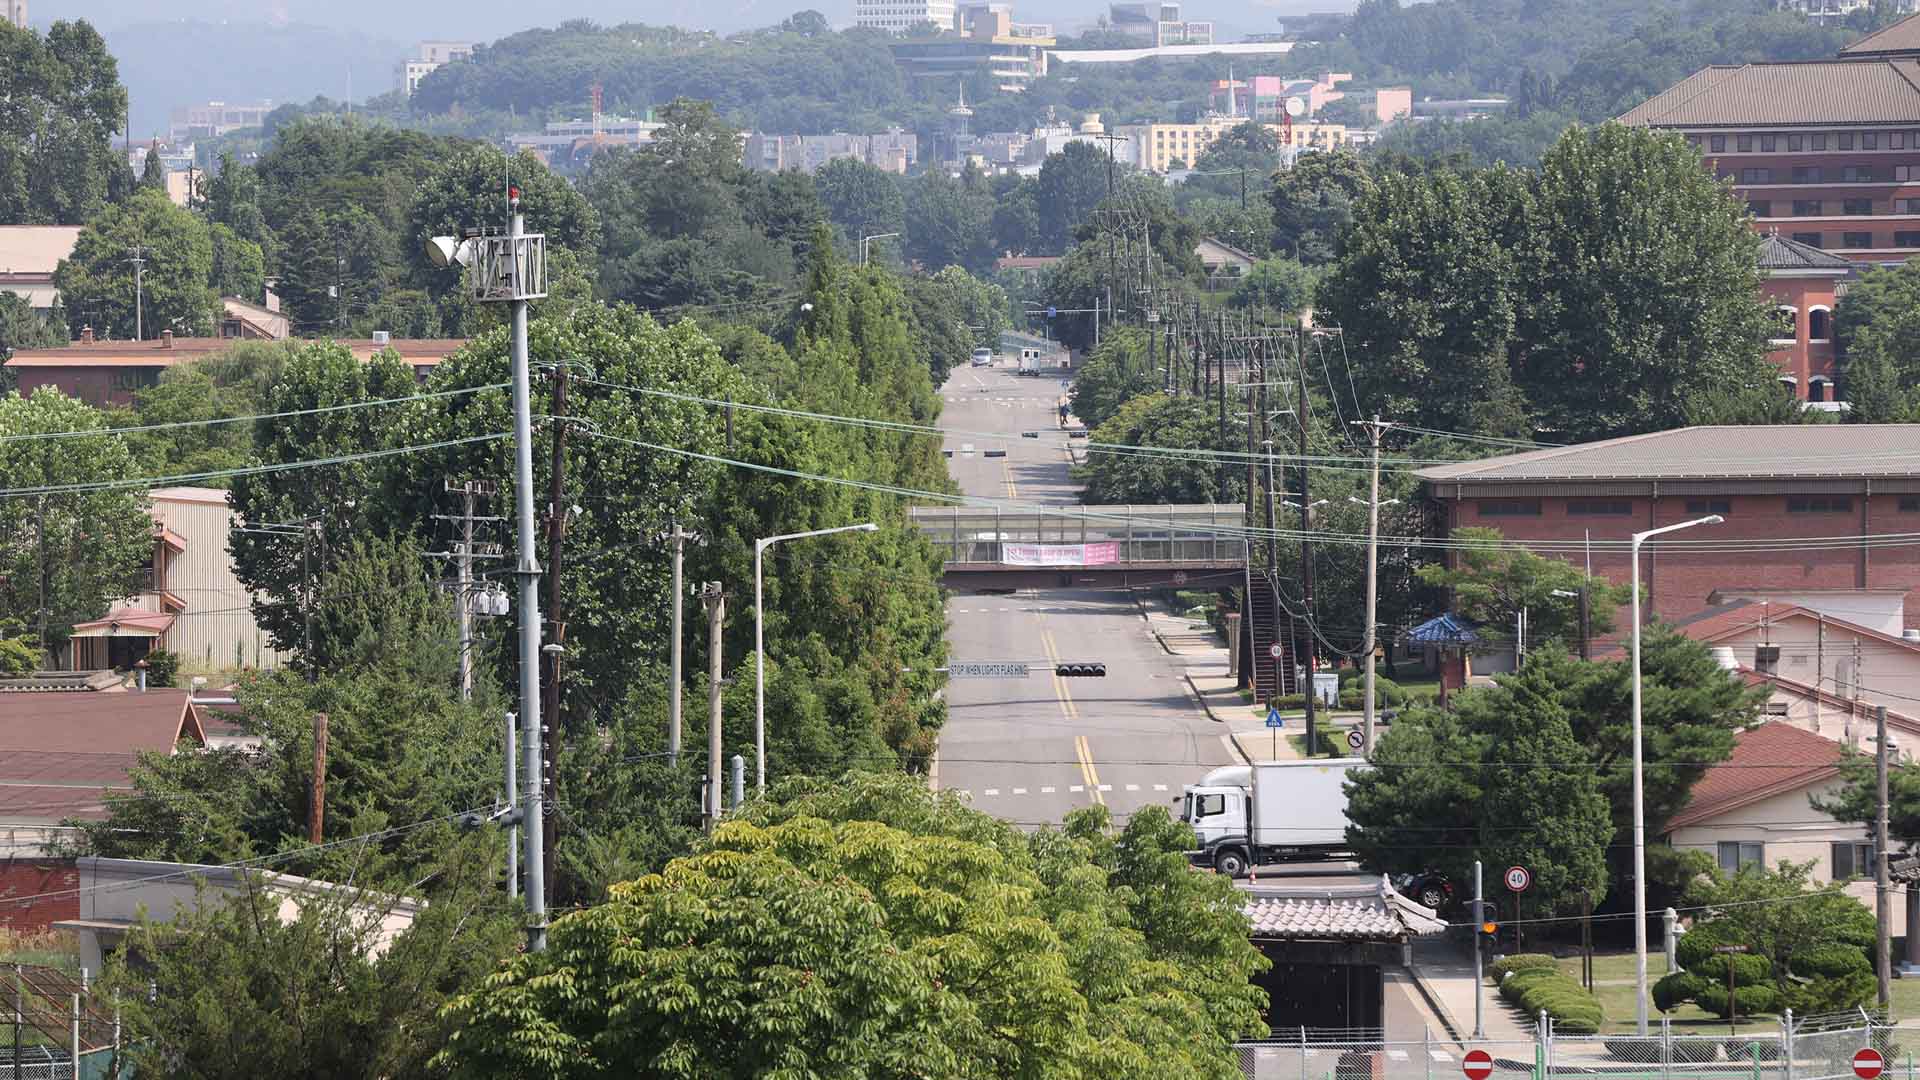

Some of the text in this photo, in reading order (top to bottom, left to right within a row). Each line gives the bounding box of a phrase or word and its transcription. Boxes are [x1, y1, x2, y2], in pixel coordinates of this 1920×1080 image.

[951, 664, 1029, 675] STOP WHEN LIGHTS FLASHING
[1511, 873, 1523, 883] 40
